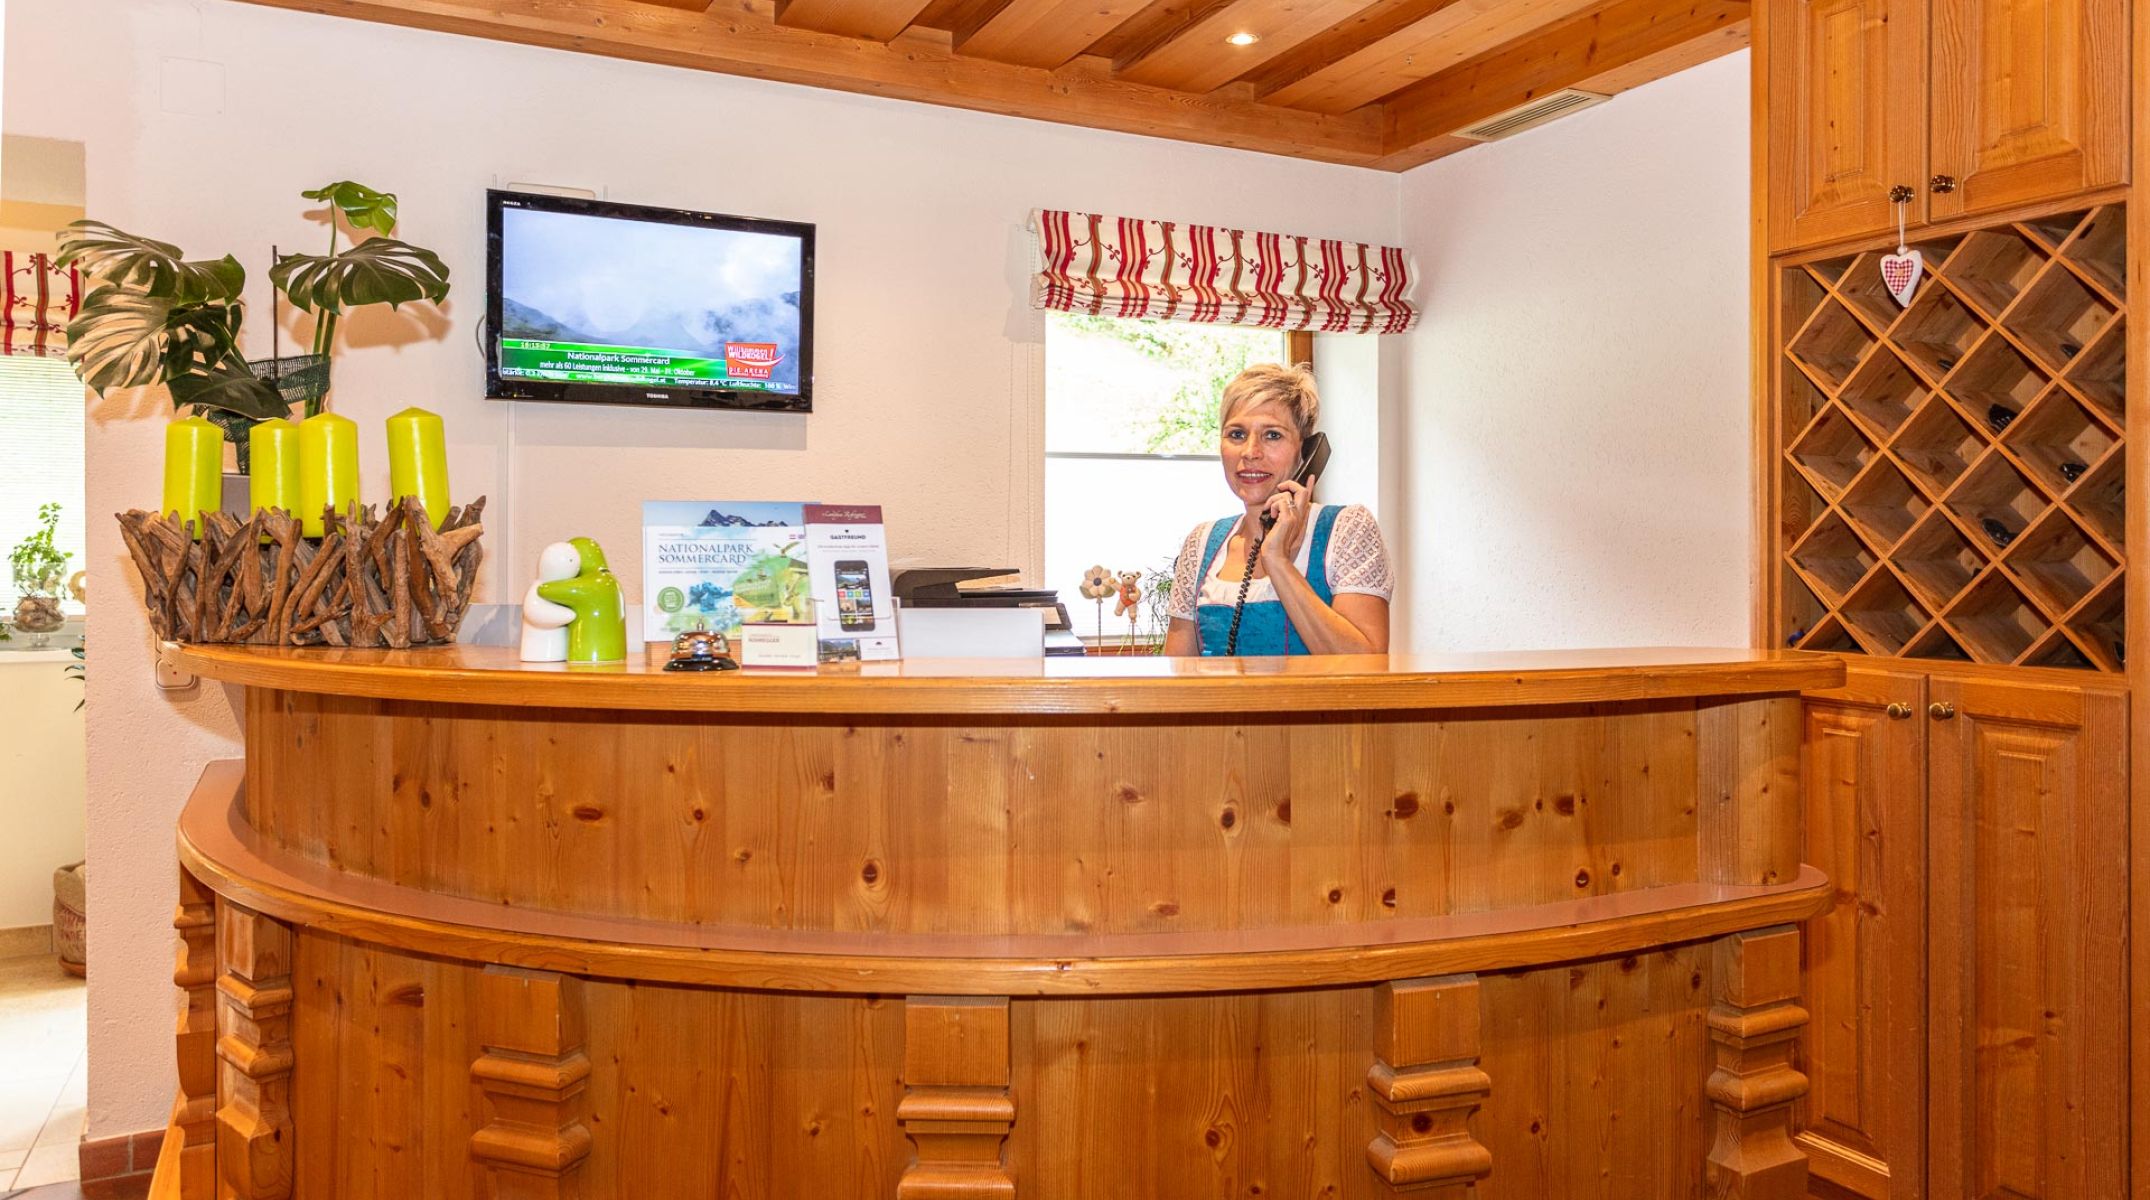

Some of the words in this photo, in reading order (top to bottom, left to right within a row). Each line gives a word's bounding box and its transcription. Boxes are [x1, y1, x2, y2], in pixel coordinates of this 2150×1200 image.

[568, 352, 620, 363] Nationalpark
[622, 355, 670, 365] Sommercard
[540, 361, 554, 369] mehr
[572, 362, 602, 372] Leistungen
[659, 544, 753, 554] NATIONALPARK
[659, 554, 747, 564] SOMMERCARD
